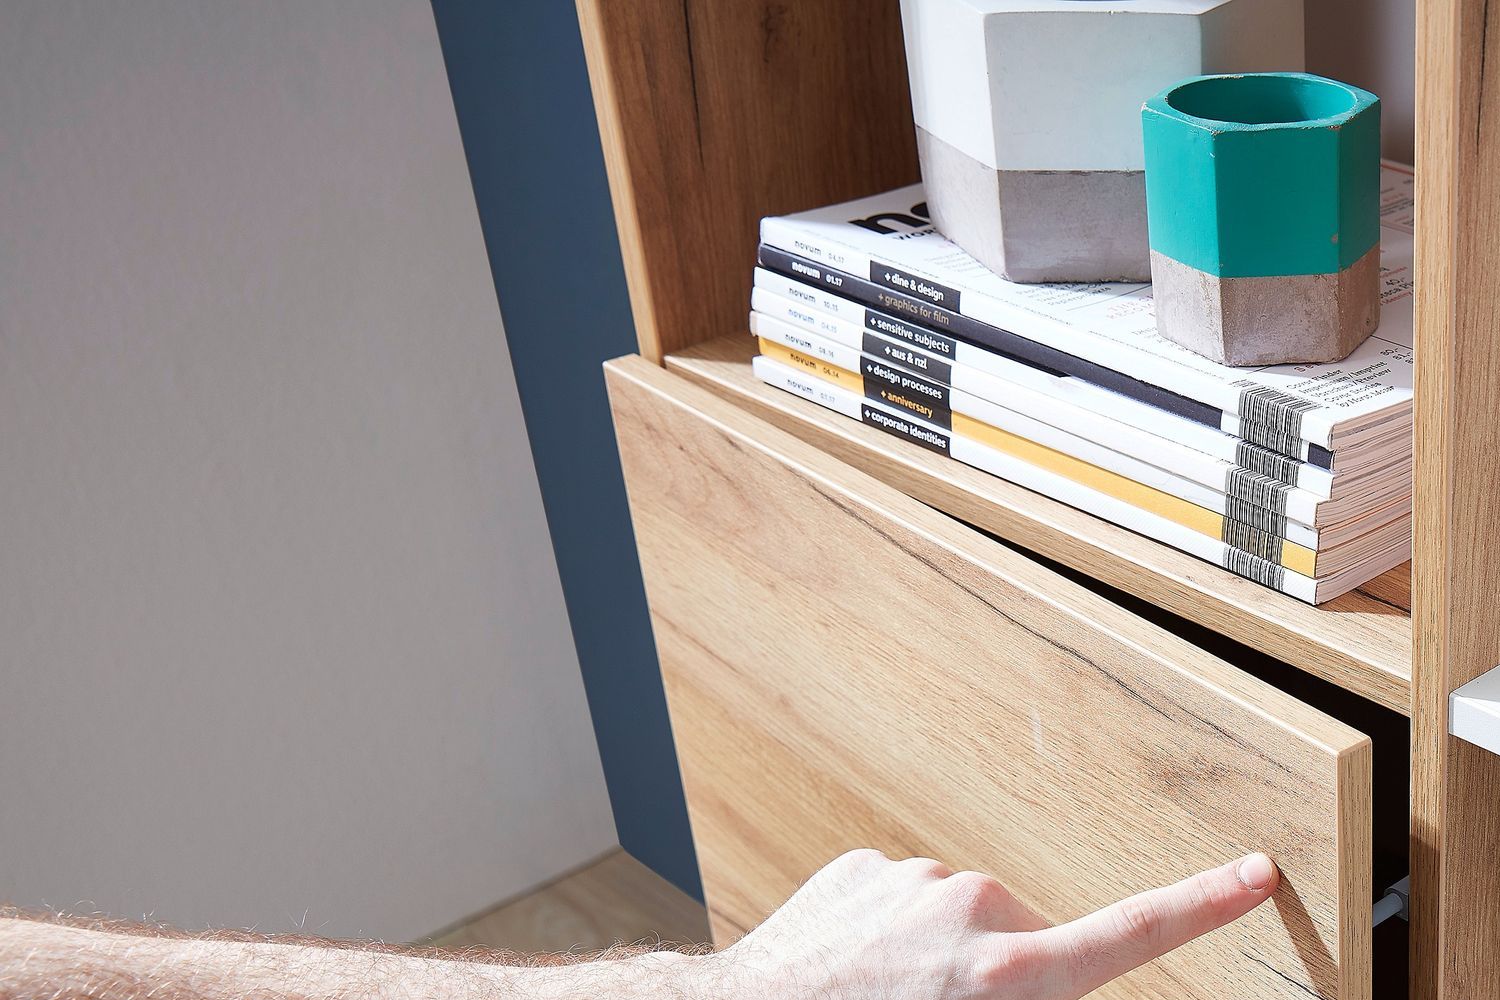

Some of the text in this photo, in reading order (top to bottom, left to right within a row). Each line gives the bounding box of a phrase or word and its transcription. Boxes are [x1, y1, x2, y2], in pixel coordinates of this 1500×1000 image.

[794, 240, 822, 256] novum
[791, 261, 821, 279] novum
[789, 287, 816, 302] novum
[891, 273, 909, 288] dine
[917, 283, 944, 301] design
[788, 309, 815, 324] novum
[884, 295, 918, 314] graphics
[920, 305, 932, 318] for
[933, 310, 949, 325] film
[785, 334, 812, 349] novum
[877, 319, 913, 340] sensitive
[914, 333, 950, 353] subjects
[790, 353, 816, 369] novum
[891, 348, 906, 363] aus
[914, 357, 928, 370] nzl
[787, 379, 814, 394] novum
[873, 365, 901, 384] design
[901, 377, 943, 399] processes
[887, 392, 933, 419] anniversary
[871, 412, 909, 434] corporate
[909, 424, 947, 449] identities
